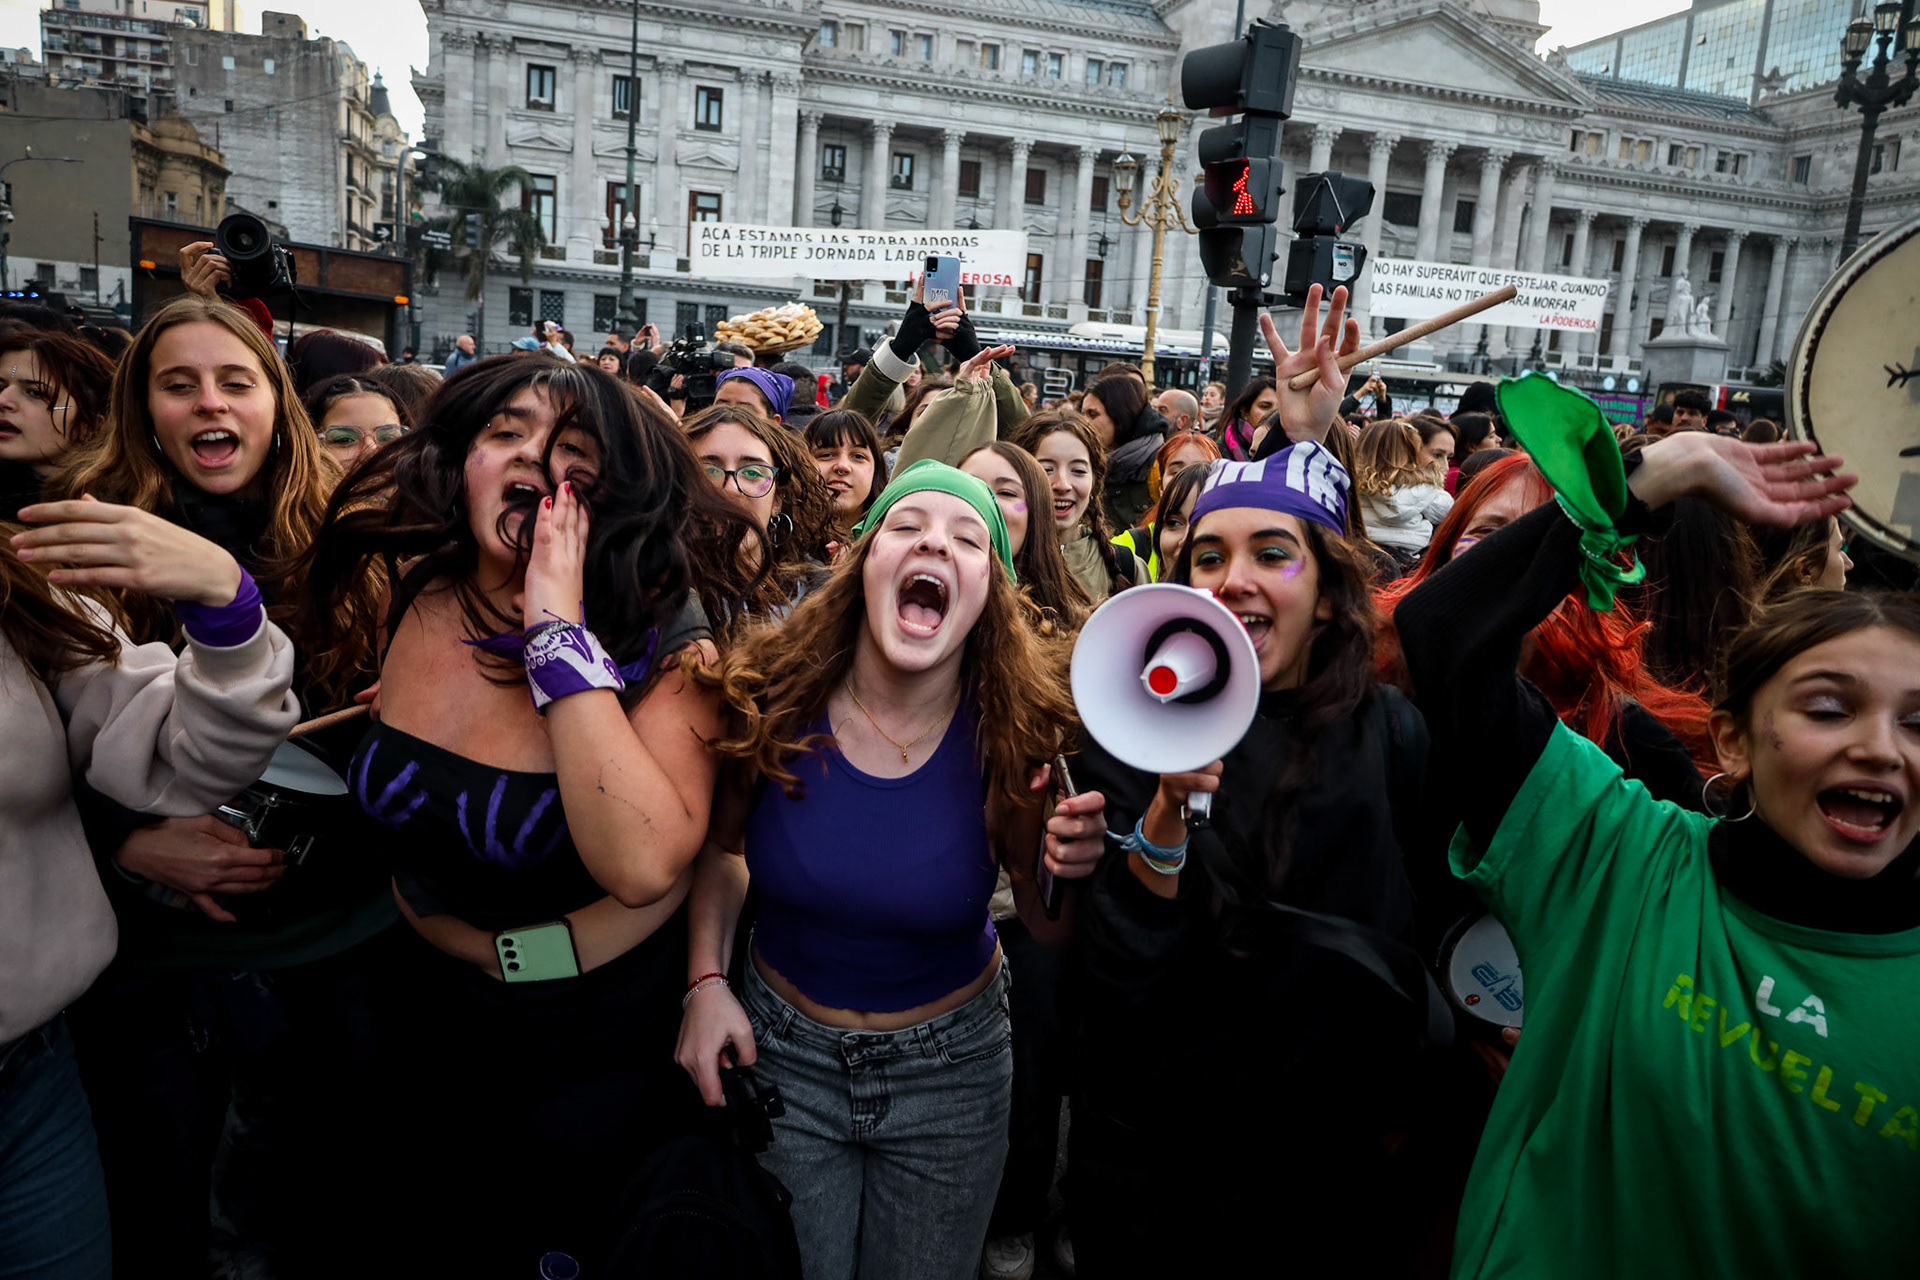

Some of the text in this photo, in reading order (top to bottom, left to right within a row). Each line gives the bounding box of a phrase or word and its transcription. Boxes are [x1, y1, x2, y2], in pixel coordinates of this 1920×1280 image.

[702, 243, 720, 257] DE
[727, 244, 744, 258] LA
[750, 245, 798, 259] TRIPLE
[805, 247, 876, 261] JORNADA
[739, 229, 813, 243] ESTAMOS
[821, 234, 850, 244] LAS
[858, 235, 979, 247] TRABAJADORAS
[1374, 262, 1390, 275] NO
[1392, 264, 1414, 277] HAY
[1478, 272, 1501, 286] QUE
[1560, 282, 1607, 297] CUANDO
[1371, 282, 1393, 295] LAS
[1395, 283, 1443, 299] FAMILIAS
[1445, 288, 1462, 301] NO
[1503, 294, 1530, 306] ARA
[1532, 297, 1577, 311] MORFAR
[1539, 315, 1597, 329] LA PODEROSA
[1756, 975, 1828, 1037] LA
[1663, 973, 1919, 1151] REVUELTA
